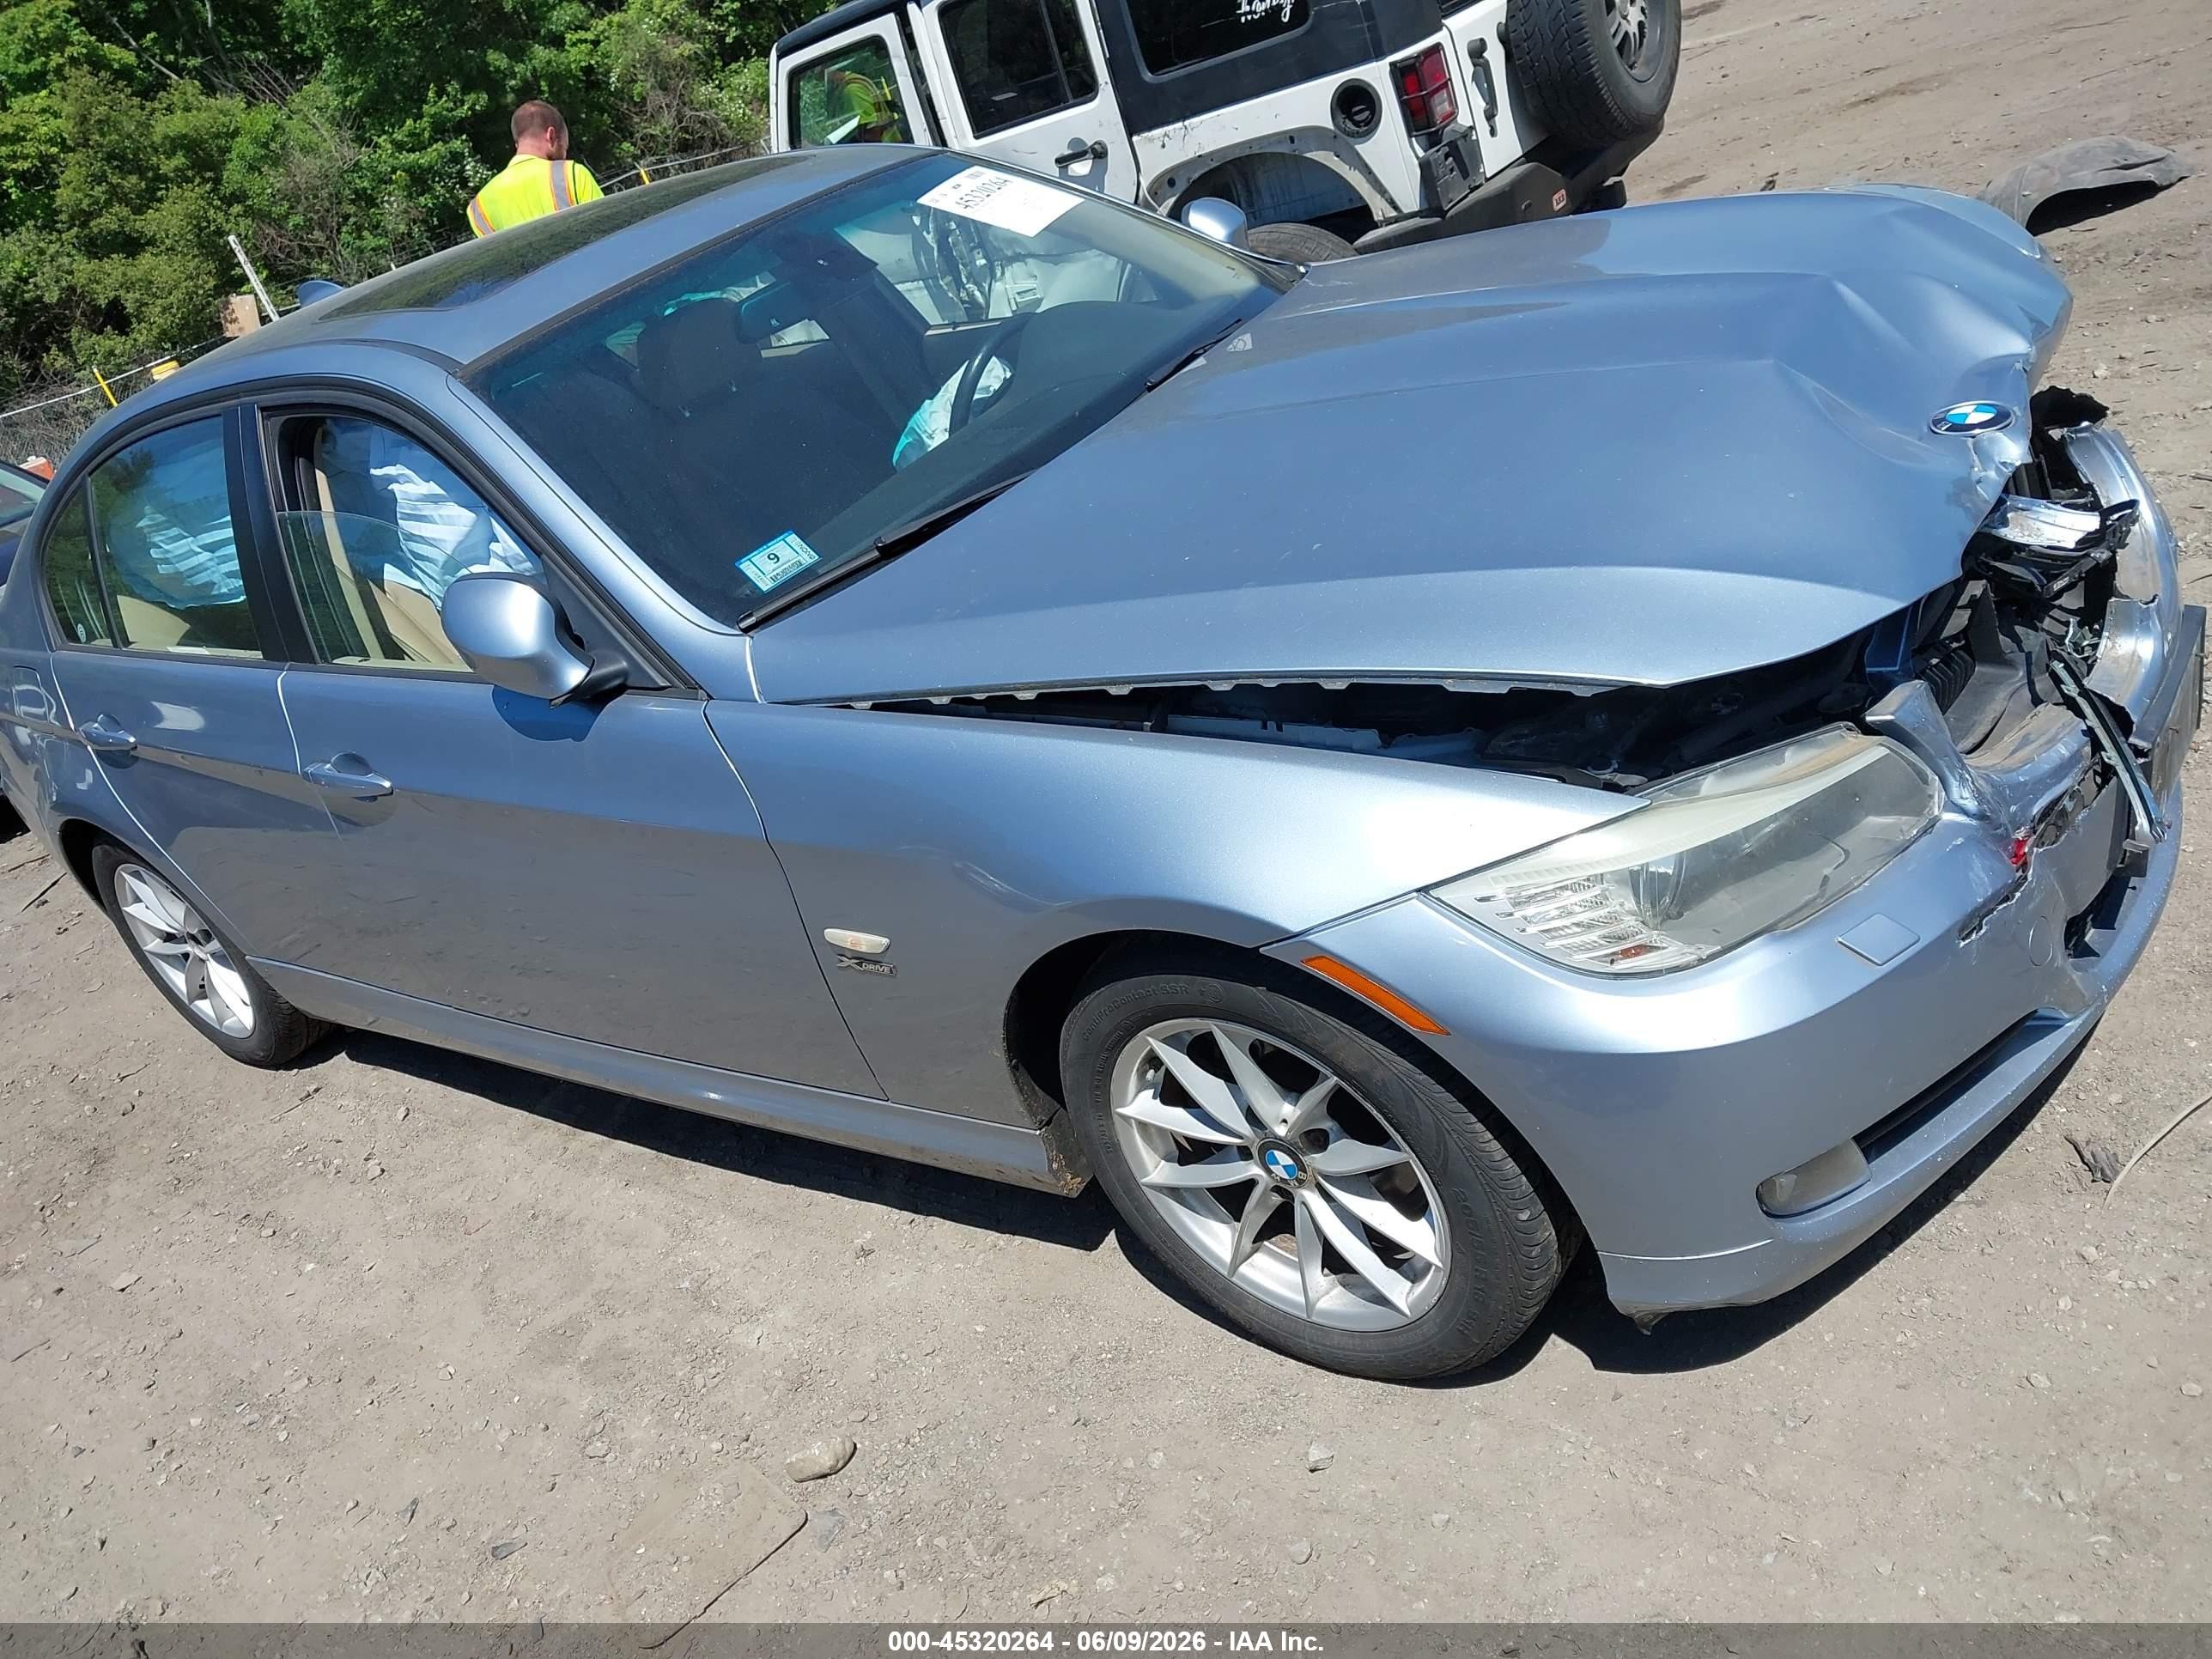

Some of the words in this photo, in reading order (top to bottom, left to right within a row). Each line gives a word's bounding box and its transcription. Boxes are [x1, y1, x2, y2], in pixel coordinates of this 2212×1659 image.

[955, 176, 1014, 210] 45320264
[766, 552, 781, 565] 9
[1161, 983, 1189, 995] SSR
